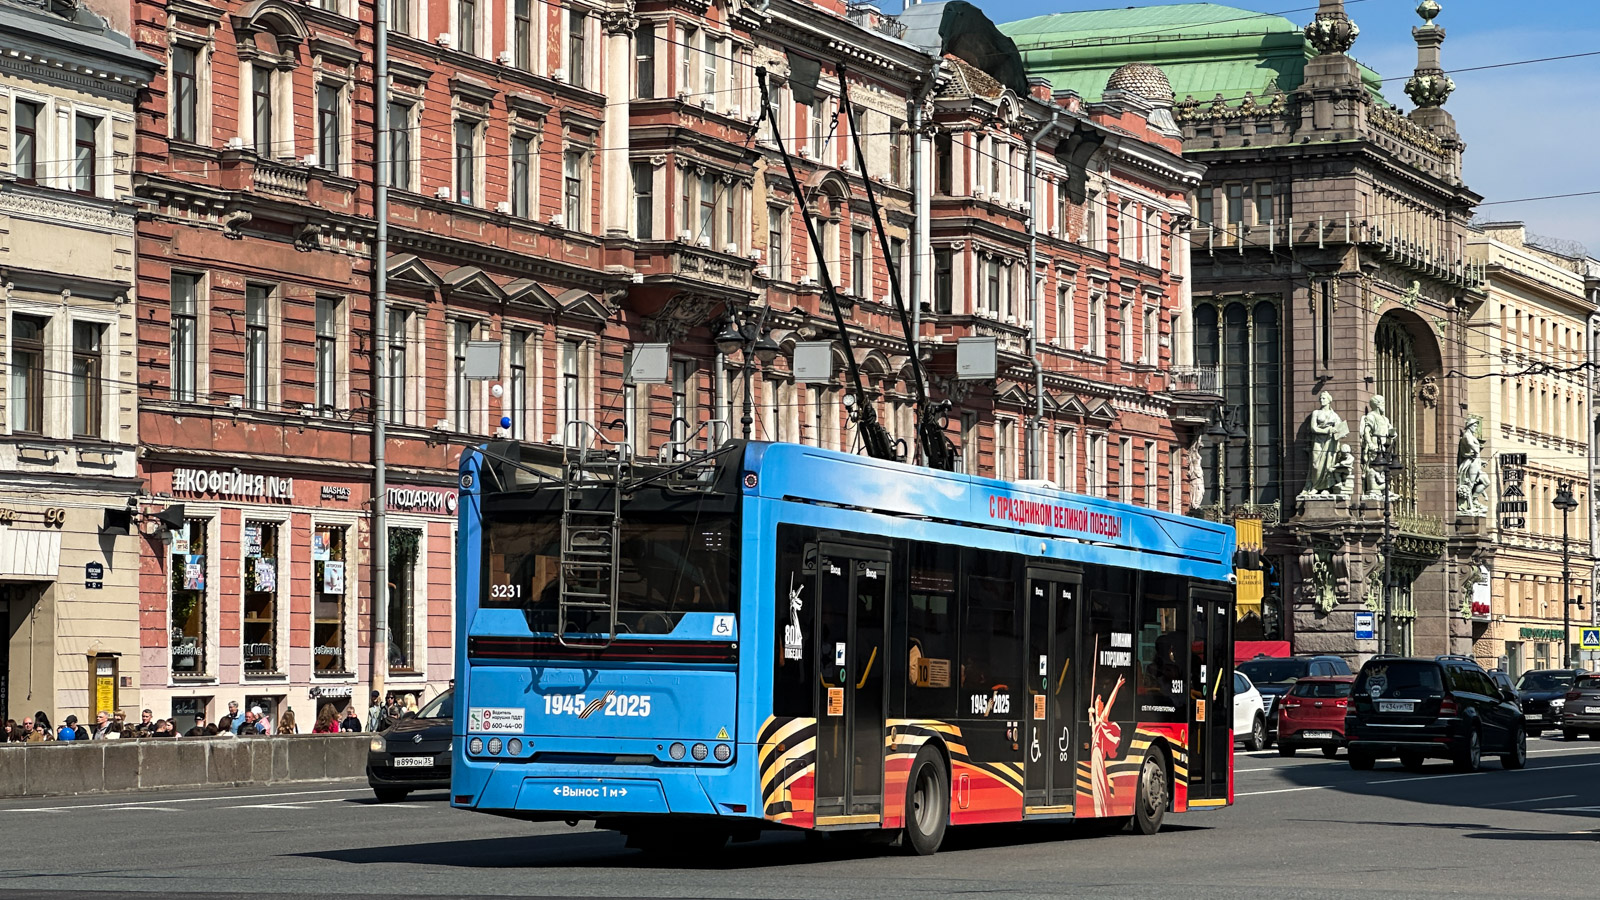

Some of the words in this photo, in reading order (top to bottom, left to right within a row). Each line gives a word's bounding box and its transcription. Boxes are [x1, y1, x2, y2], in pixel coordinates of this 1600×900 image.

[174, 467, 264, 496] #КОФЕЙНЯ
[267, 476, 294, 498] №1
[322, 486, 351, 495] MASHA'S
[386, 488, 442, 508] ПОДАРКИ
[47, 508, 66, 523] 90
[989, 495, 995, 518] С
[997, 497, 1051, 526] ПРАЗДНИКОМ
[1054, 505, 1088, 532] ВЕЛИКОЙ
[1090, 512, 1122, 539] ПОБЕДЫ!
[830, 564, 841, 576] Вход
[866, 568, 877, 579] Вход
[491, 585, 521, 598] 3231
[785, 624, 795, 644] 80
[919, 665, 928, 682] 10
[1171, 680, 1183, 693] 3231
[543, 694, 586, 715] 1945
[604, 694, 651, 716] 2025
[970, 694, 987, 714] 1945
[993, 694, 1010, 714] 2025
[396, 757, 422, 766] В899ОН
[562, 786, 599, 797] Вынос
[602, 786, 607, 797] 1
[609, 789, 618, 797] м
